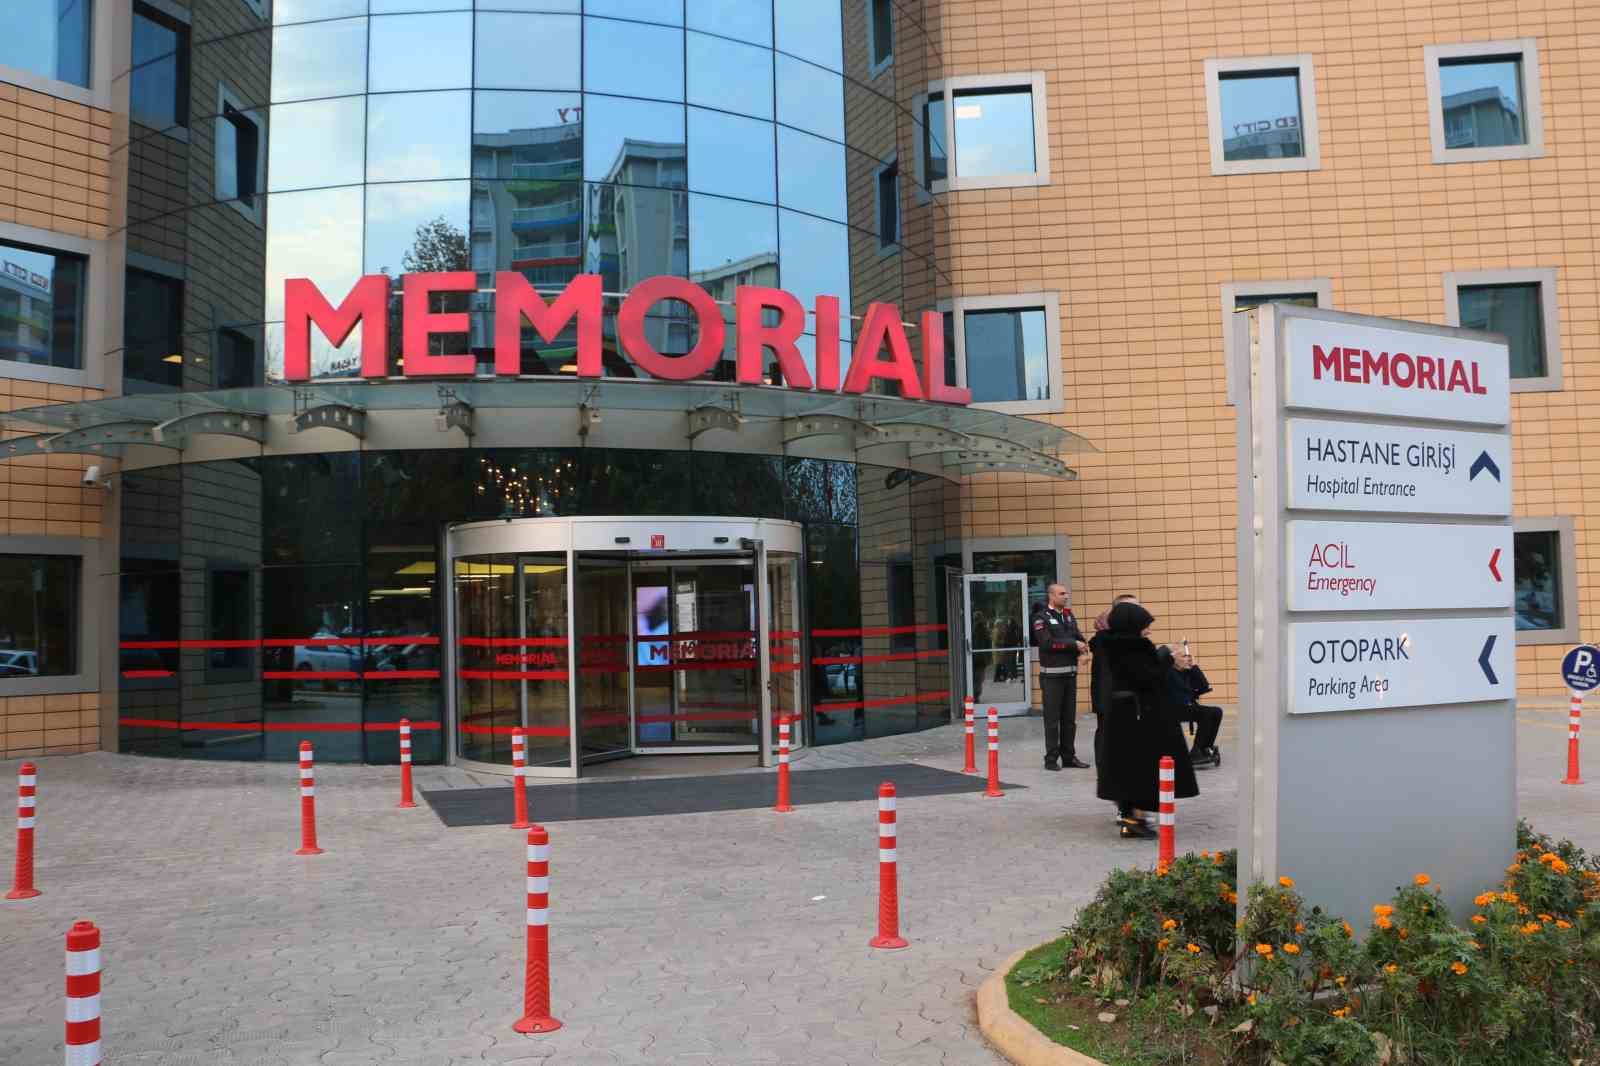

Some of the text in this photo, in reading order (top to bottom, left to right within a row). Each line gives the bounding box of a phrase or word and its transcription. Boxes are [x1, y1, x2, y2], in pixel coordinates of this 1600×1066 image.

[284, 271, 972, 405] MEMORIAL
[1312, 344, 1487, 395] MEMORIAL
[1306, 437, 1456, 475] HASTANE GİRİŞİ
[1306, 475, 1416, 499] Hospital Entrance
[1308, 541, 1356, 569] ACİL
[1307, 571, 1377, 596] Emergency
[1308, 634, 1410, 665] OTOPARK
[1573, 650, 1592, 673] P
[1308, 674, 1389, 700] Parking Area
